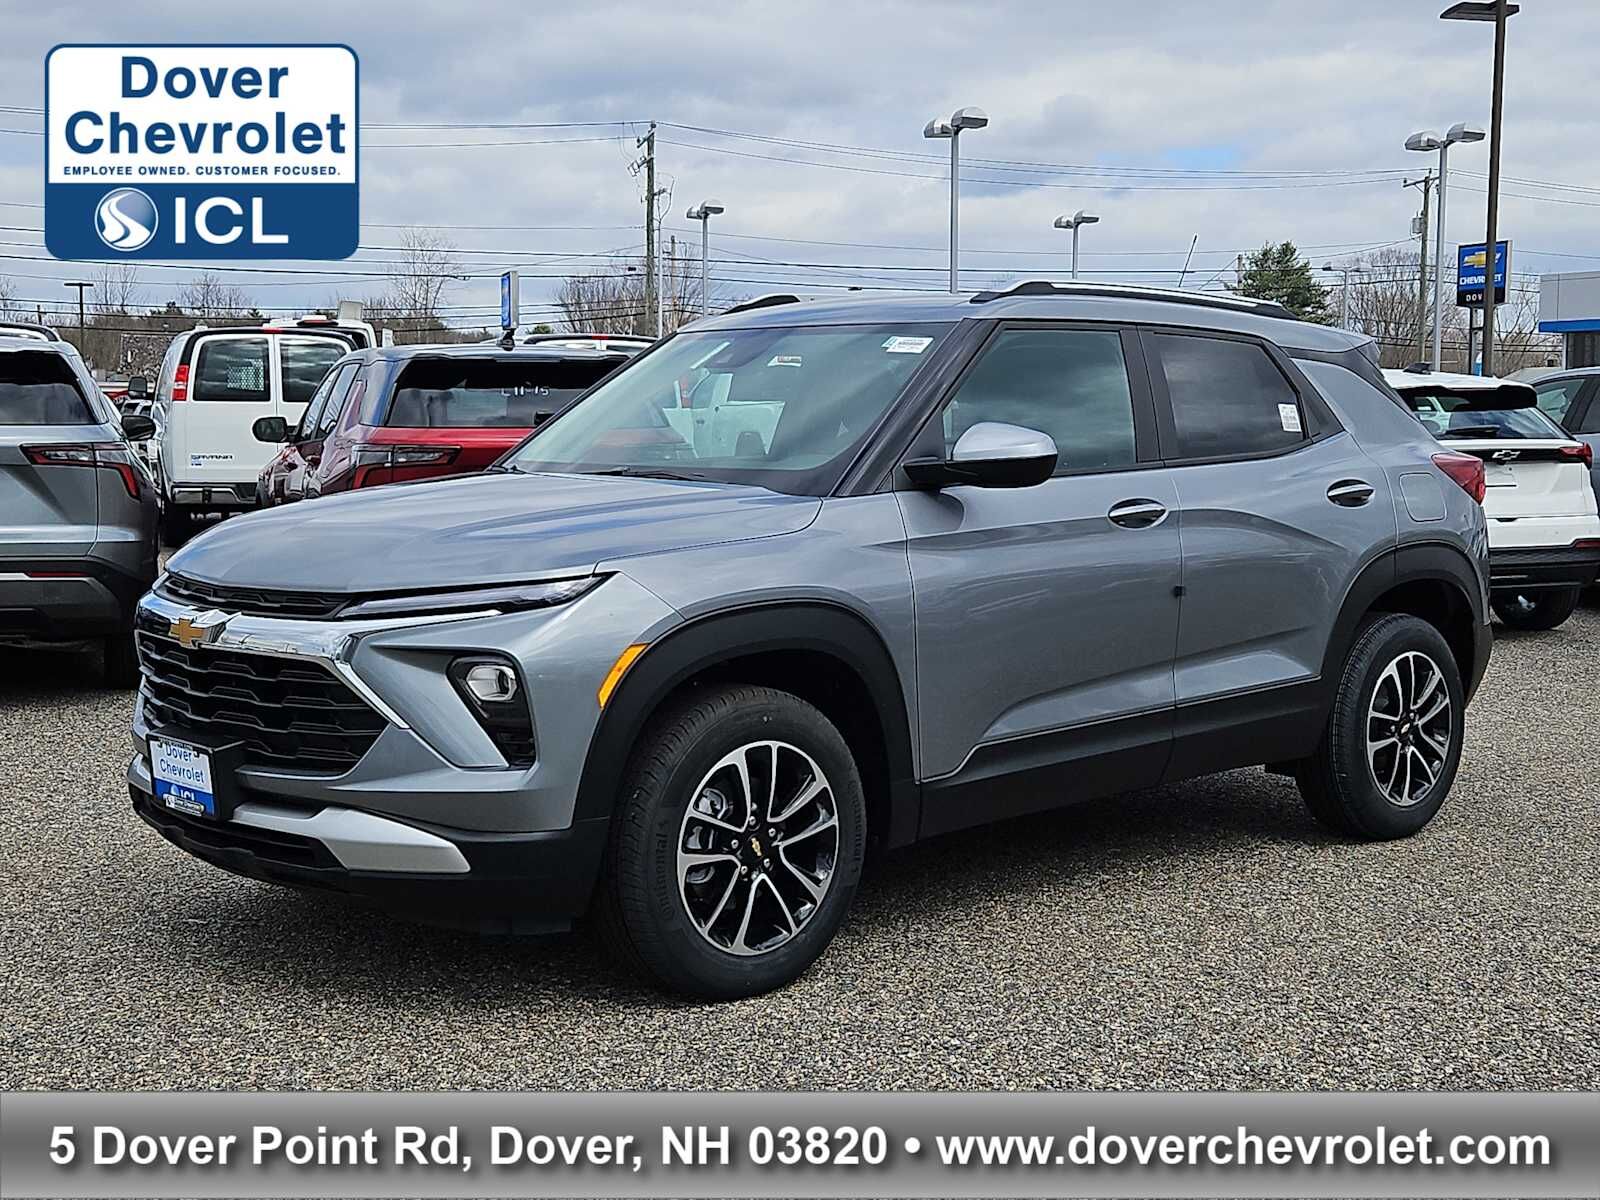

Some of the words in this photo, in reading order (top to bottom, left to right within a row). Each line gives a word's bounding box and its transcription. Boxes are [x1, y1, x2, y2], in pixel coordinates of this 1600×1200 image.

[1459, 273, 1502, 285] CHEVRET
[165, 744, 193, 762] Dover
[160, 758, 204, 784] Chevrolet
